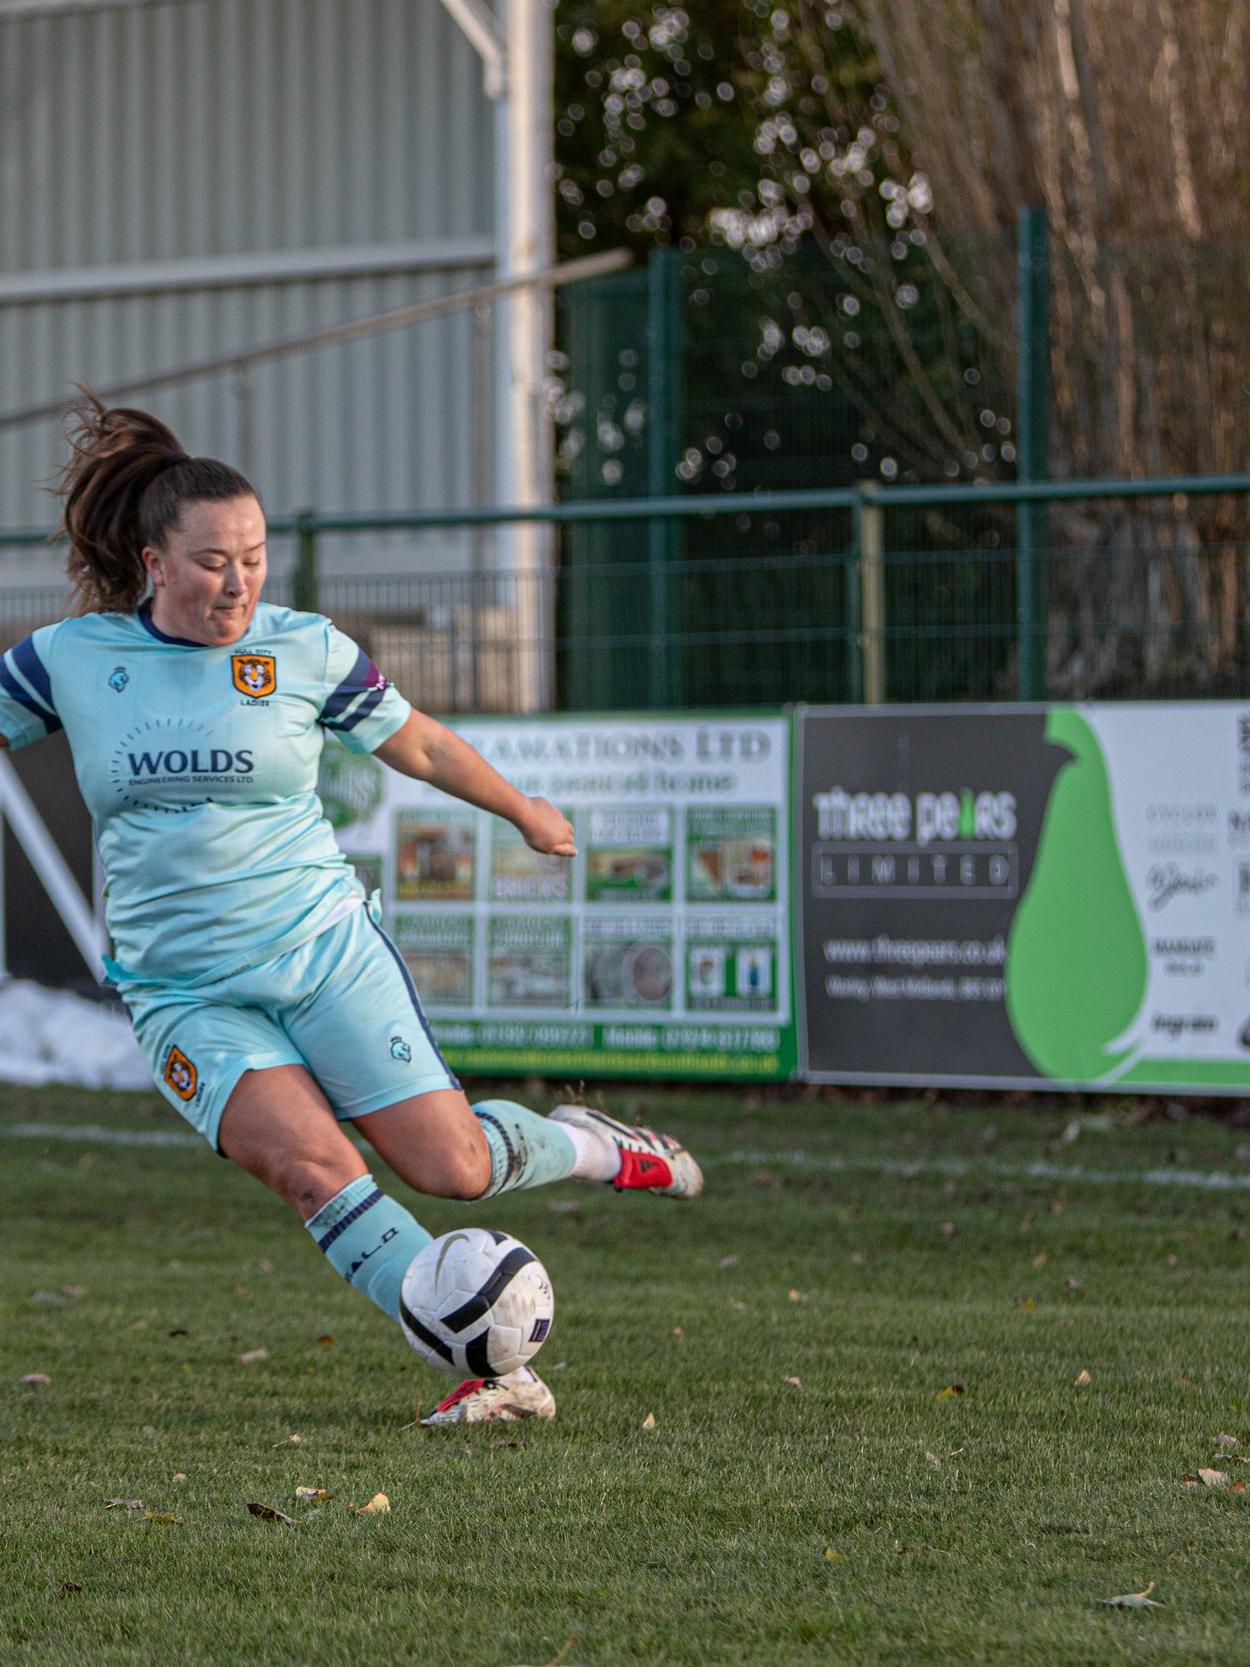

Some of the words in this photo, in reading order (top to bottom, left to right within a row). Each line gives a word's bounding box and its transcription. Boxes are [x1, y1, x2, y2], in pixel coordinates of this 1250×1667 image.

[127, 749, 254, 777] WOLDS
[128, 775, 190, 786] ENGINEERING
[191, 774, 235, 784] SERVICES
[820, 854, 1009, 886] LIMITED
